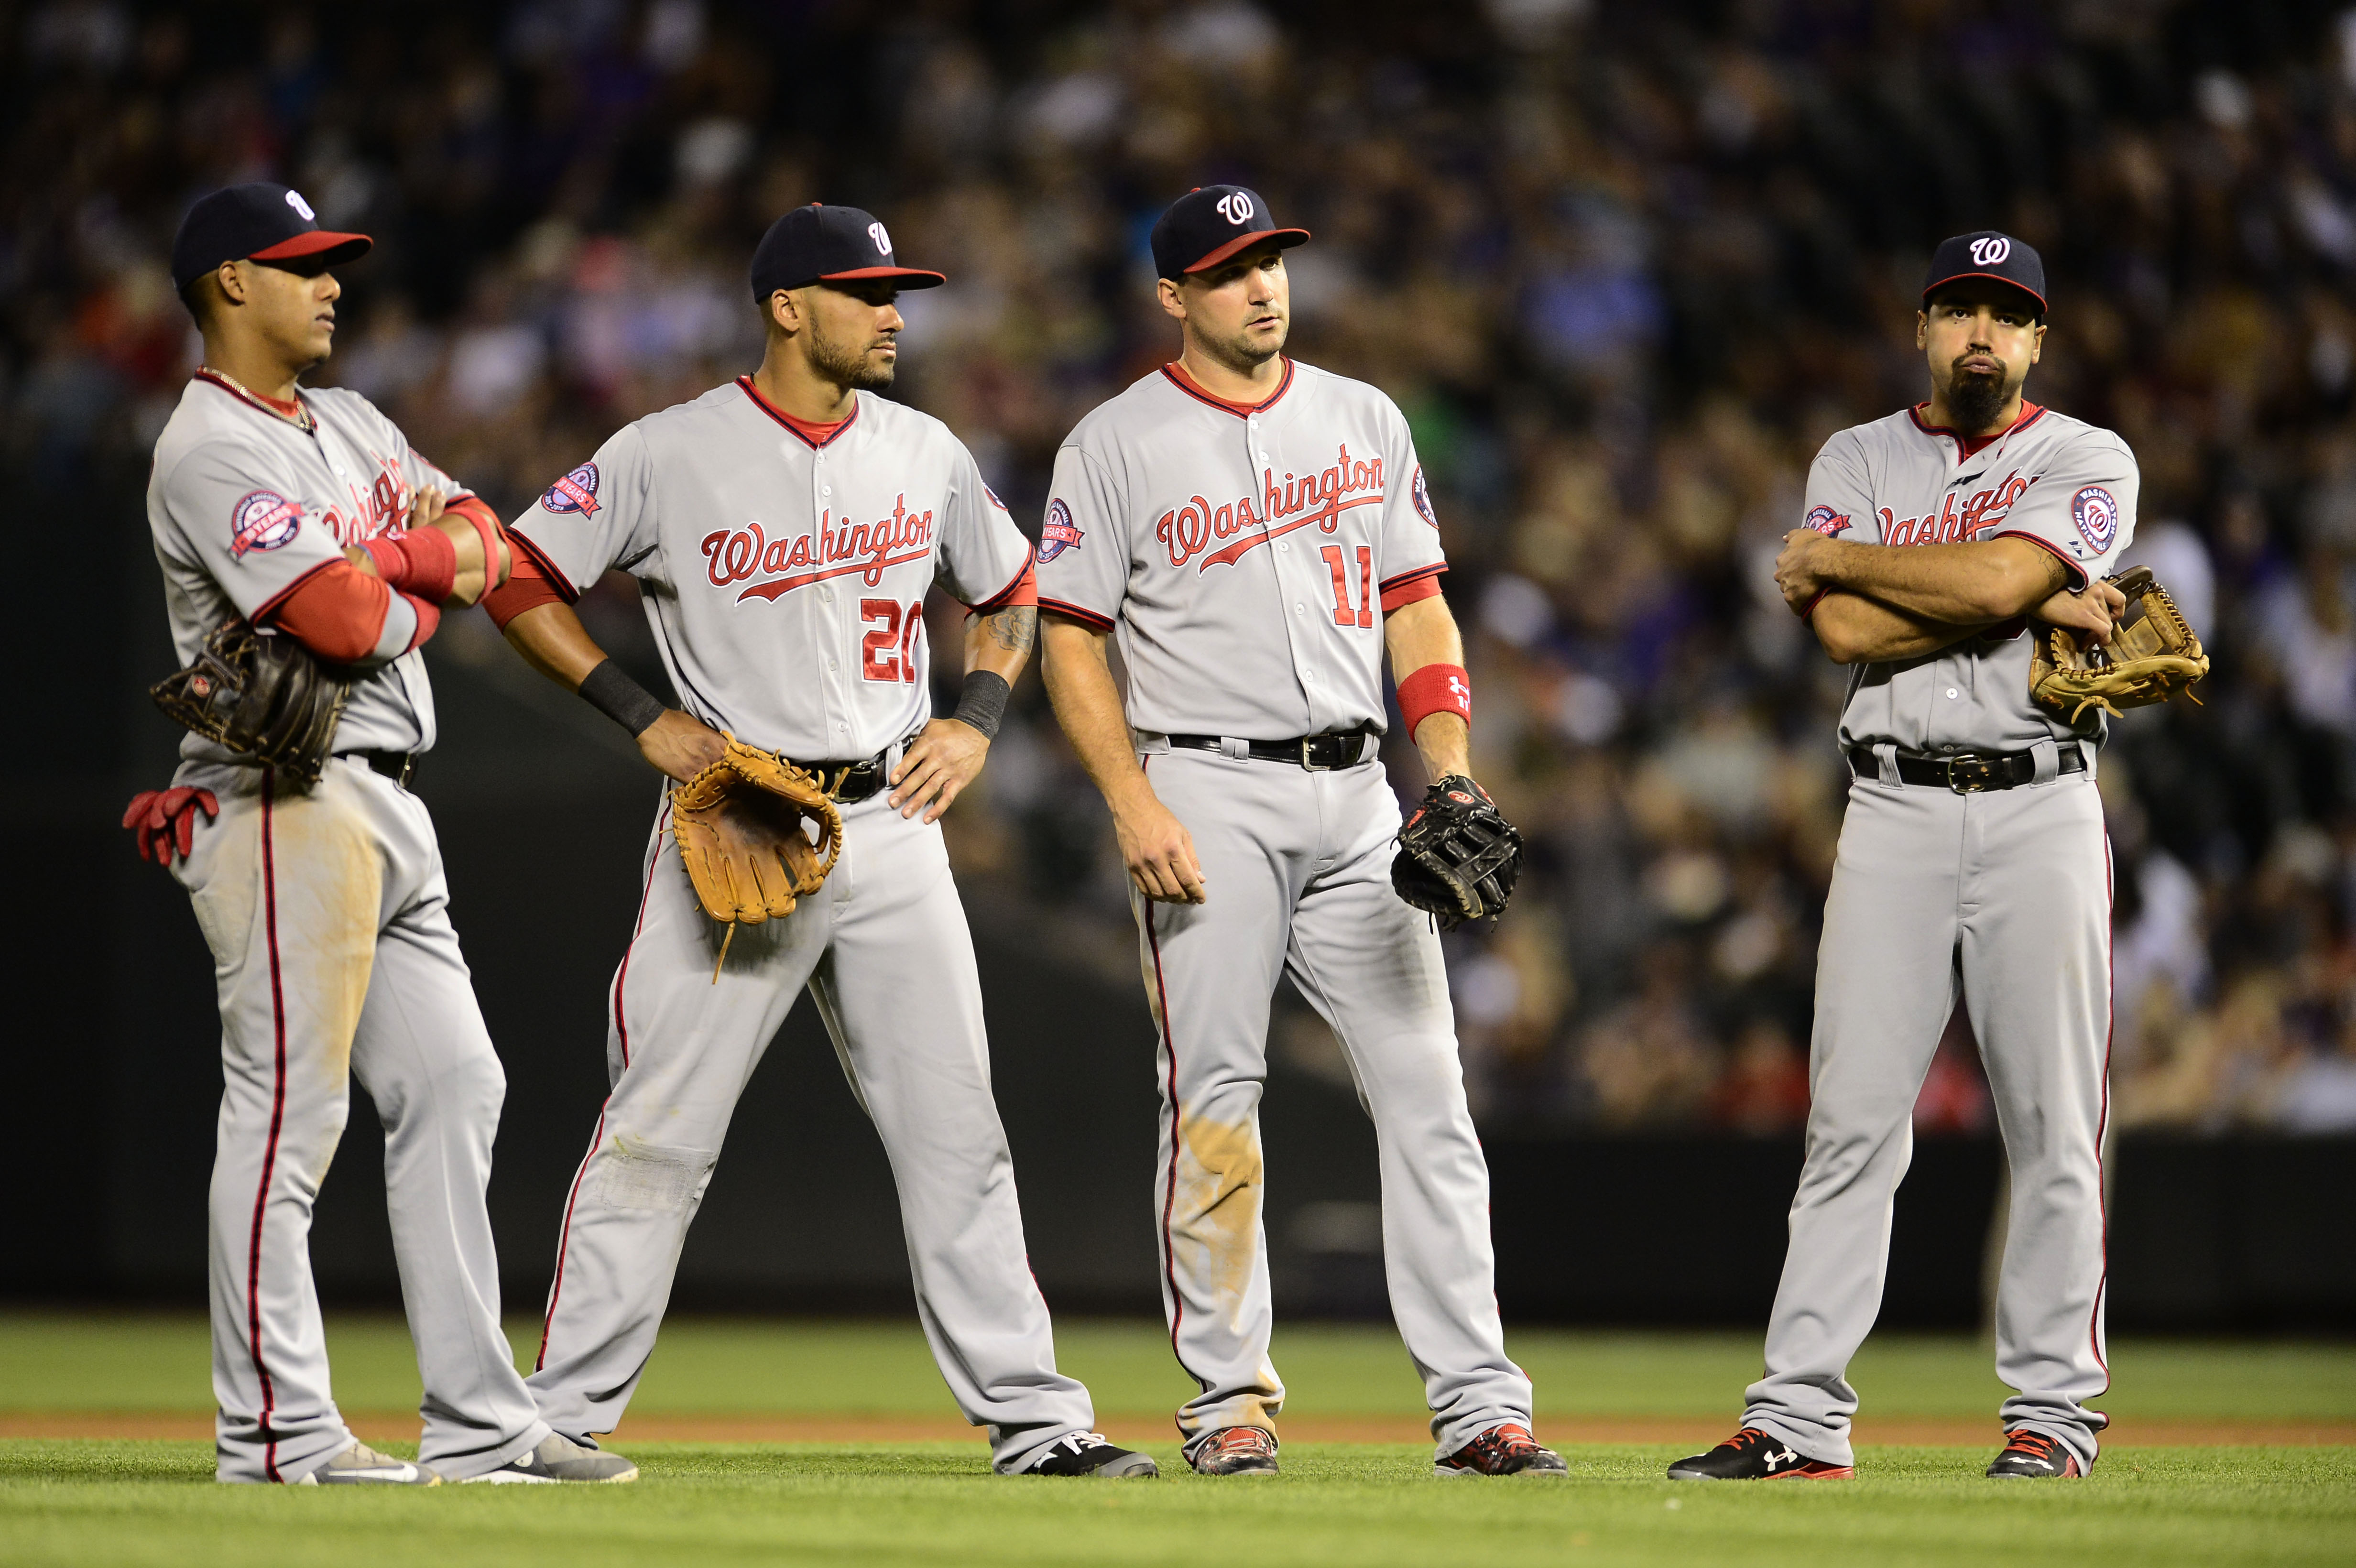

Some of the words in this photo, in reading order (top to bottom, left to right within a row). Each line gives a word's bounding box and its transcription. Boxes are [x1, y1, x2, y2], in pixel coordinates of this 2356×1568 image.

[1217, 191, 1254, 226] W
[1969, 237, 2010, 266] W
[563, 482, 587, 503] YEARS
[1156, 443, 1385, 568] Washington
[2074, 512, 2106, 550] NATIONALS
[2080, 489, 2117, 535] WASHINGTON
[2088, 504, 2109, 533] W
[701, 492, 933, 588] Washington
[1319, 544, 1373, 629] 11
